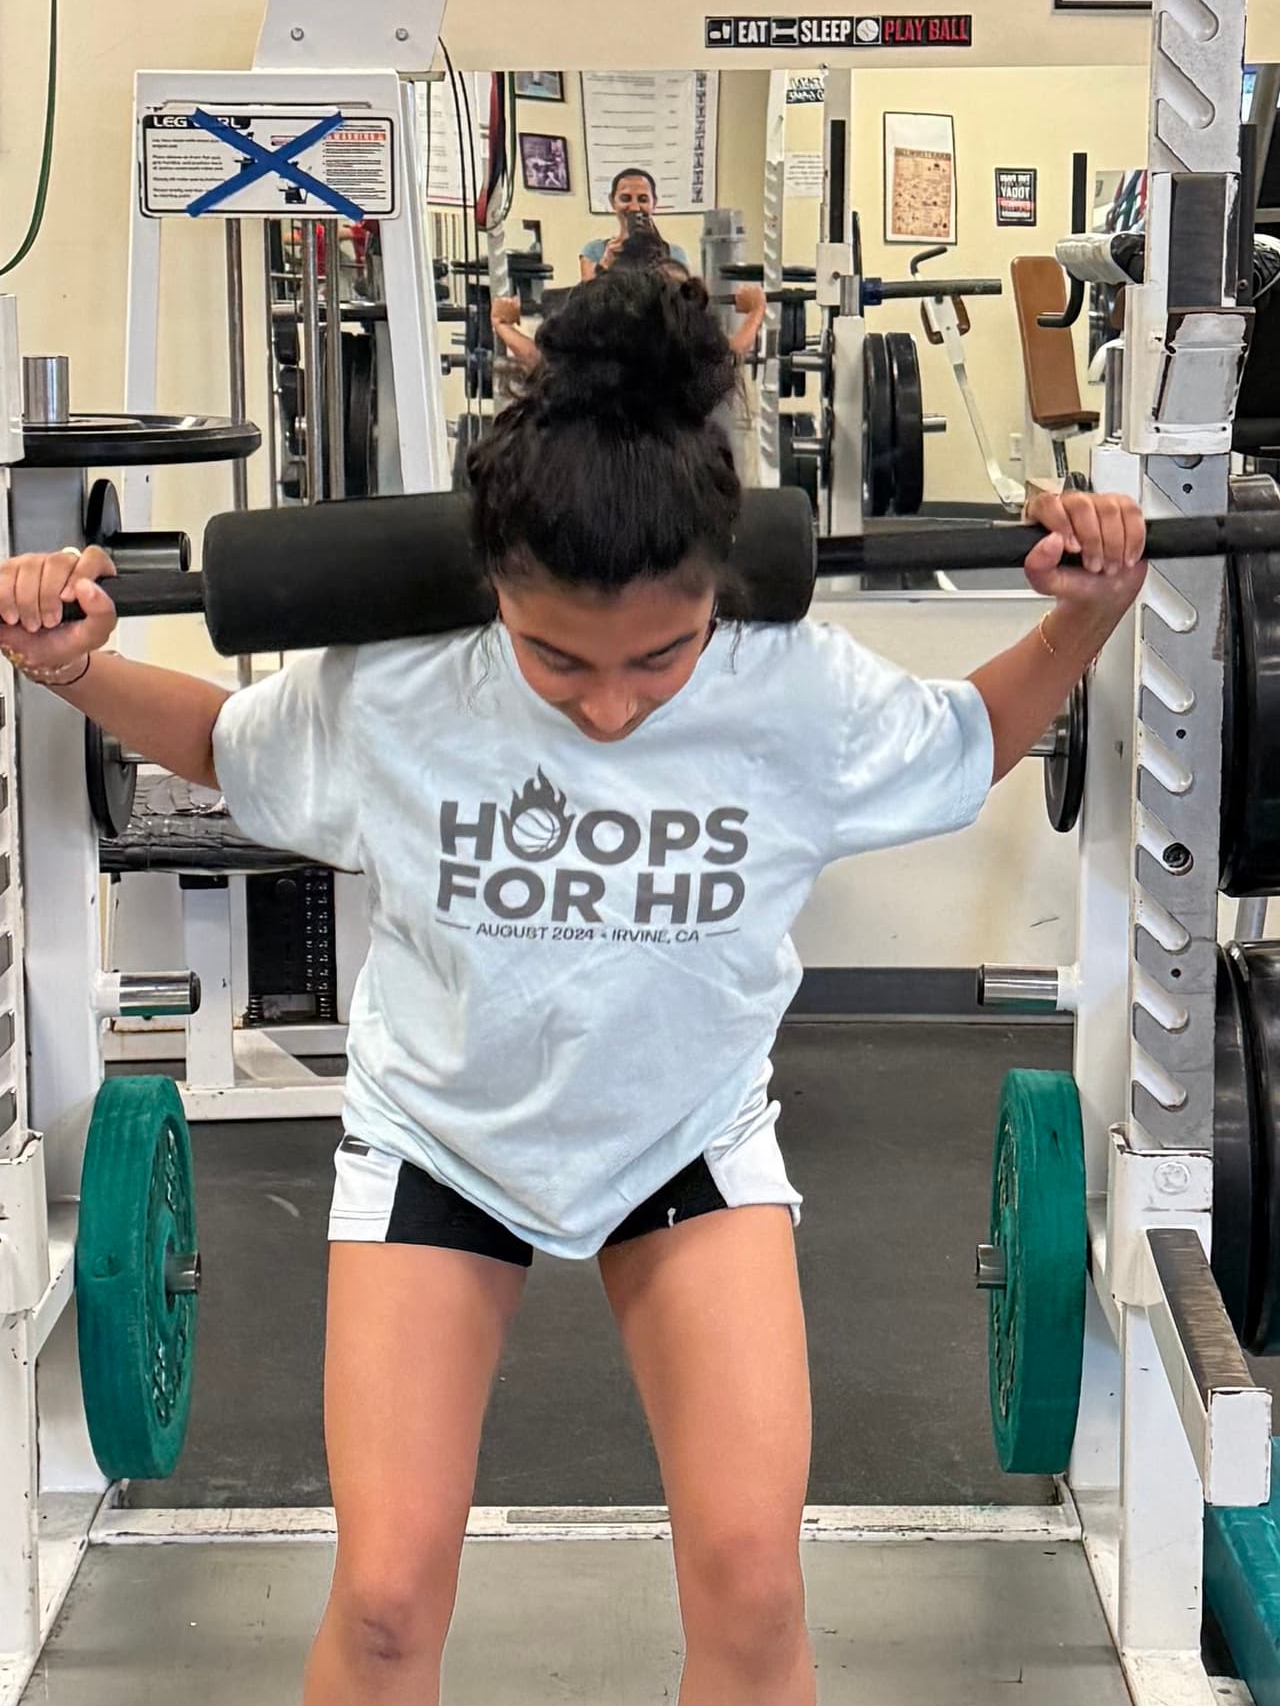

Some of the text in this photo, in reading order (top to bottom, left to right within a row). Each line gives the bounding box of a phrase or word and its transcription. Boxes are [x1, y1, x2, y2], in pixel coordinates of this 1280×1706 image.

[738, 18, 969, 43] EAT SLEEP PLAY BALL
[152, 116, 188, 128] LEG
[439, 798, 749, 867] HOOPS
[437, 859, 746, 924] FOR HD
[476, 923, 699, 944] AUGUST 2024 IRVINE, CA
